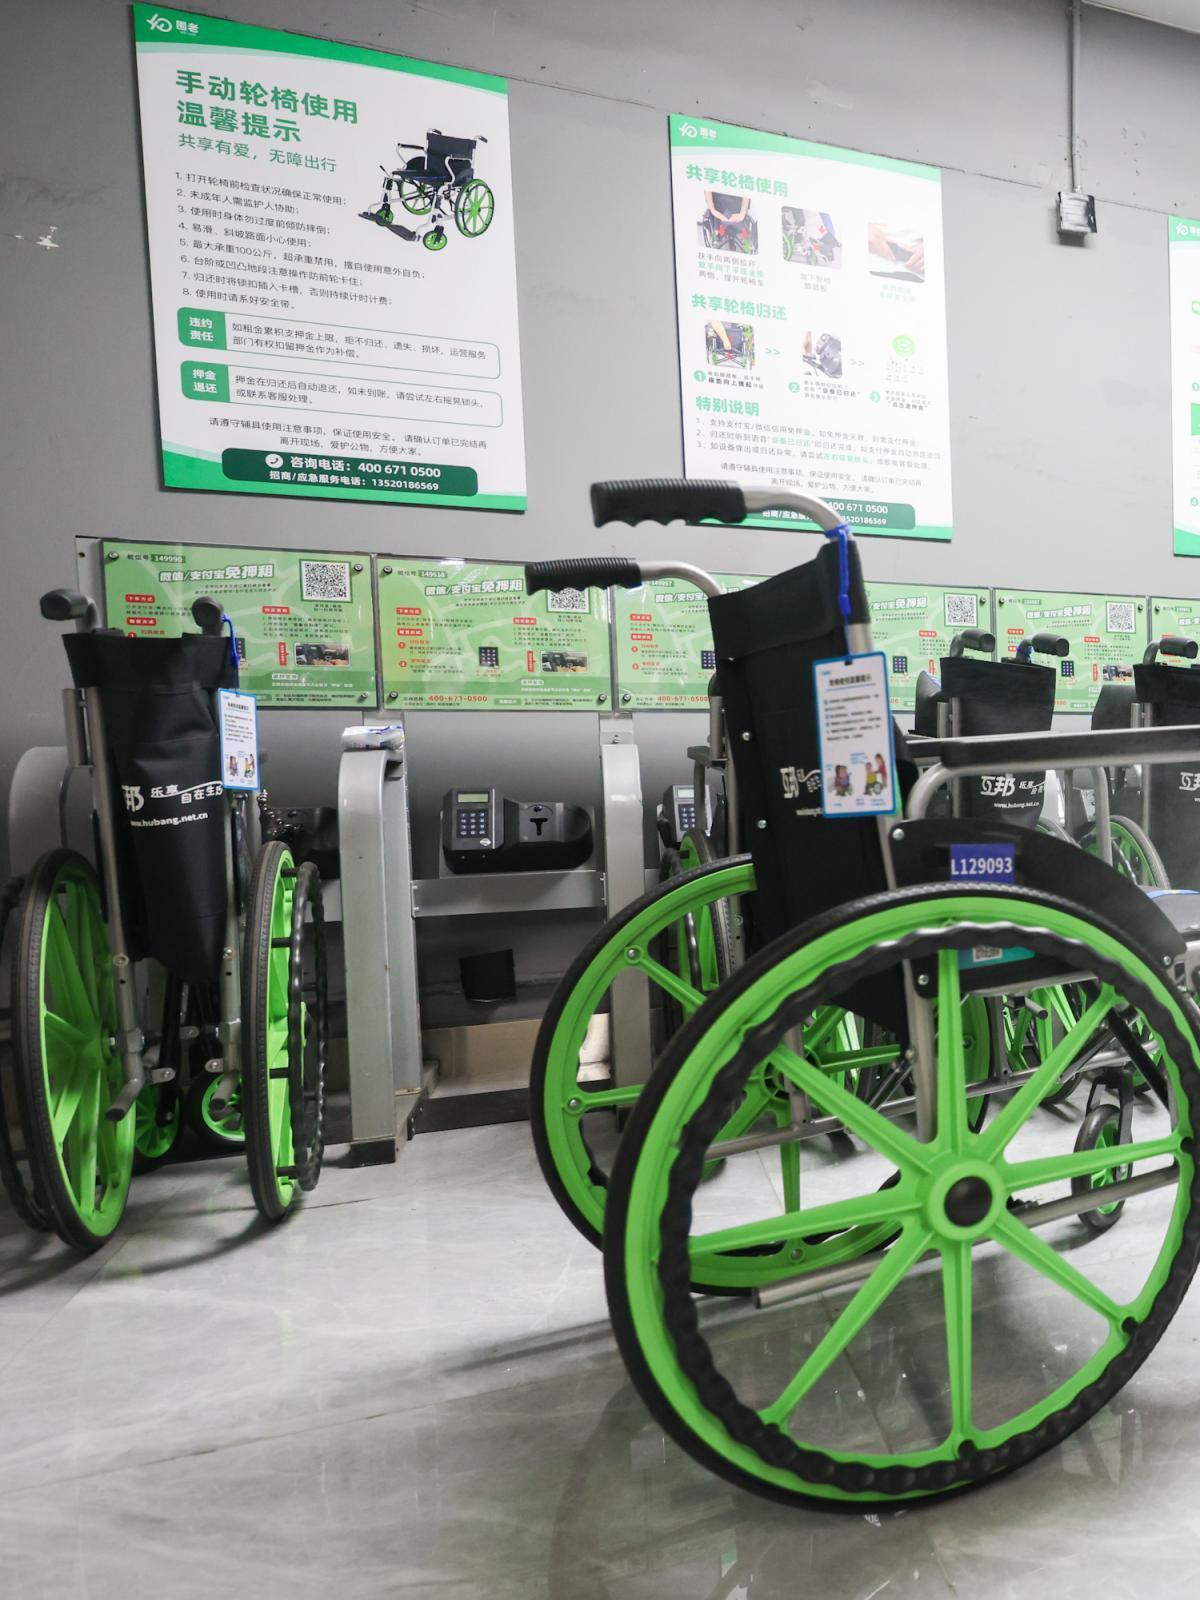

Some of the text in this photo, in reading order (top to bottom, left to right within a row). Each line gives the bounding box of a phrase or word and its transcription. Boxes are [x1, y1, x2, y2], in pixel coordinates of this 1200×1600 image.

[176, 69, 358, 124] 手动轮椅使用
[177, 100, 301, 141] 温馨提示
[686, 164, 788, 197] 共享轮椅使用
[691, 293, 787, 320] 共享轮椅归还
[192, 369, 216, 380] 押金
[695, 396, 760, 416] 特别说明
[358, 463, 382, 475] 400
[384, 465, 406, 476] 671
[409, 466, 441, 478] 0500
[372, 478, 439, 491] 13520186569
[848, 503, 863, 511] 671
[865, 504, 888, 514] 0500
[951, 858, 1013, 875] L129093
